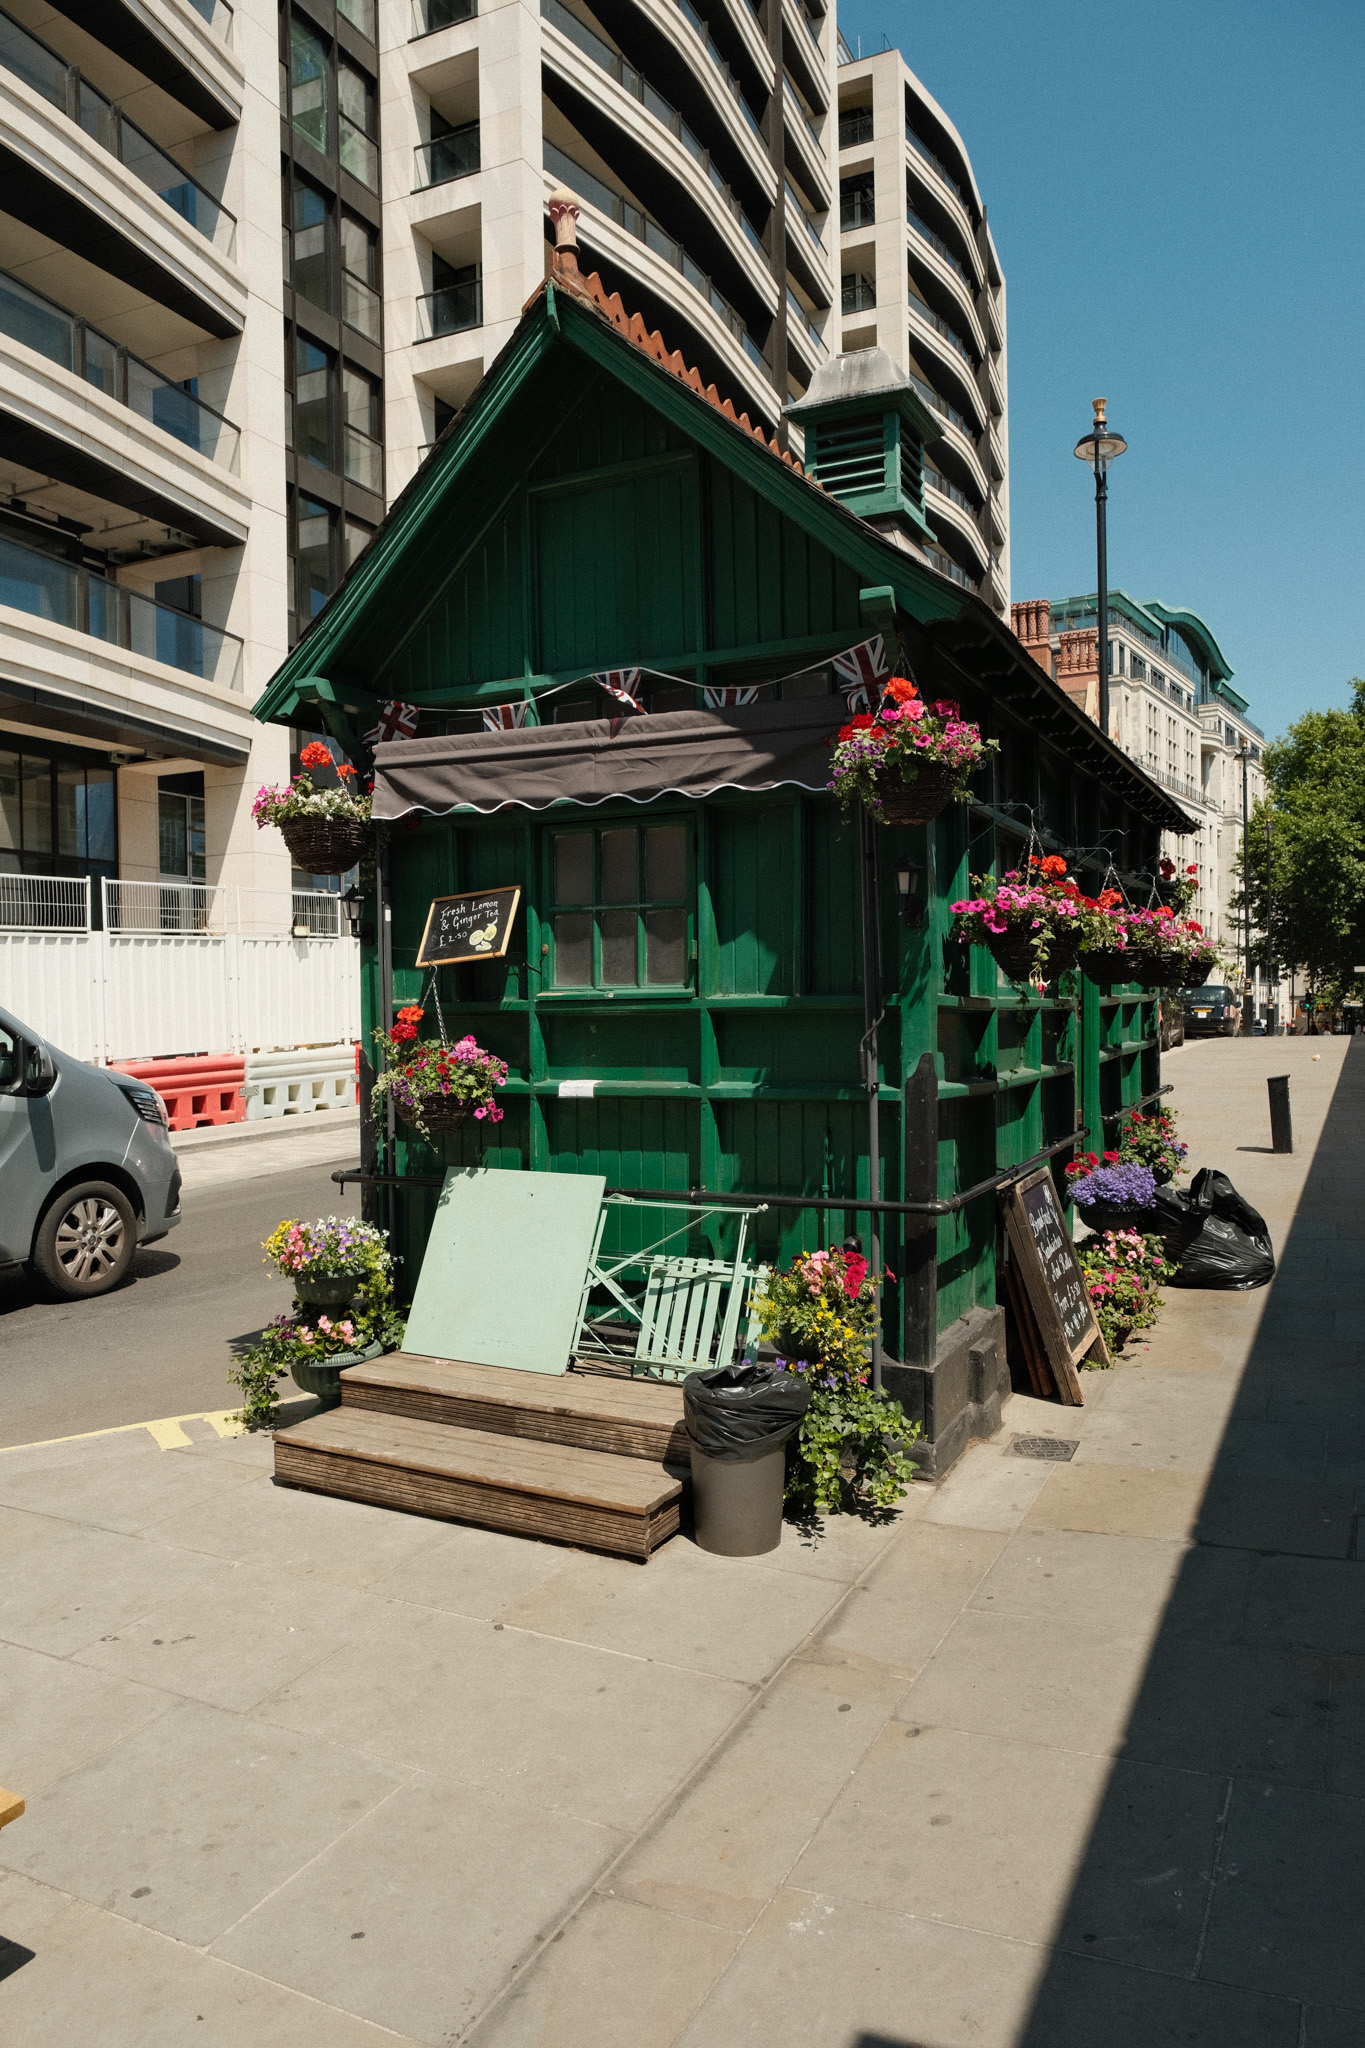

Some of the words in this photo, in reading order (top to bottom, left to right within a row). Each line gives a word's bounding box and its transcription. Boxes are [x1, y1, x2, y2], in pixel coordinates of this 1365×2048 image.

[440, 904, 466, 921] Fresh
[472, 901, 498, 911] Lemon
[441, 920, 449, 930] &
[453, 913, 481, 930] Ginger
[485, 909, 499, 918] Tea
[1029, 1205, 1053, 1238] Breakfast
[1041, 1233, 1063, 1264] Sandwiches
